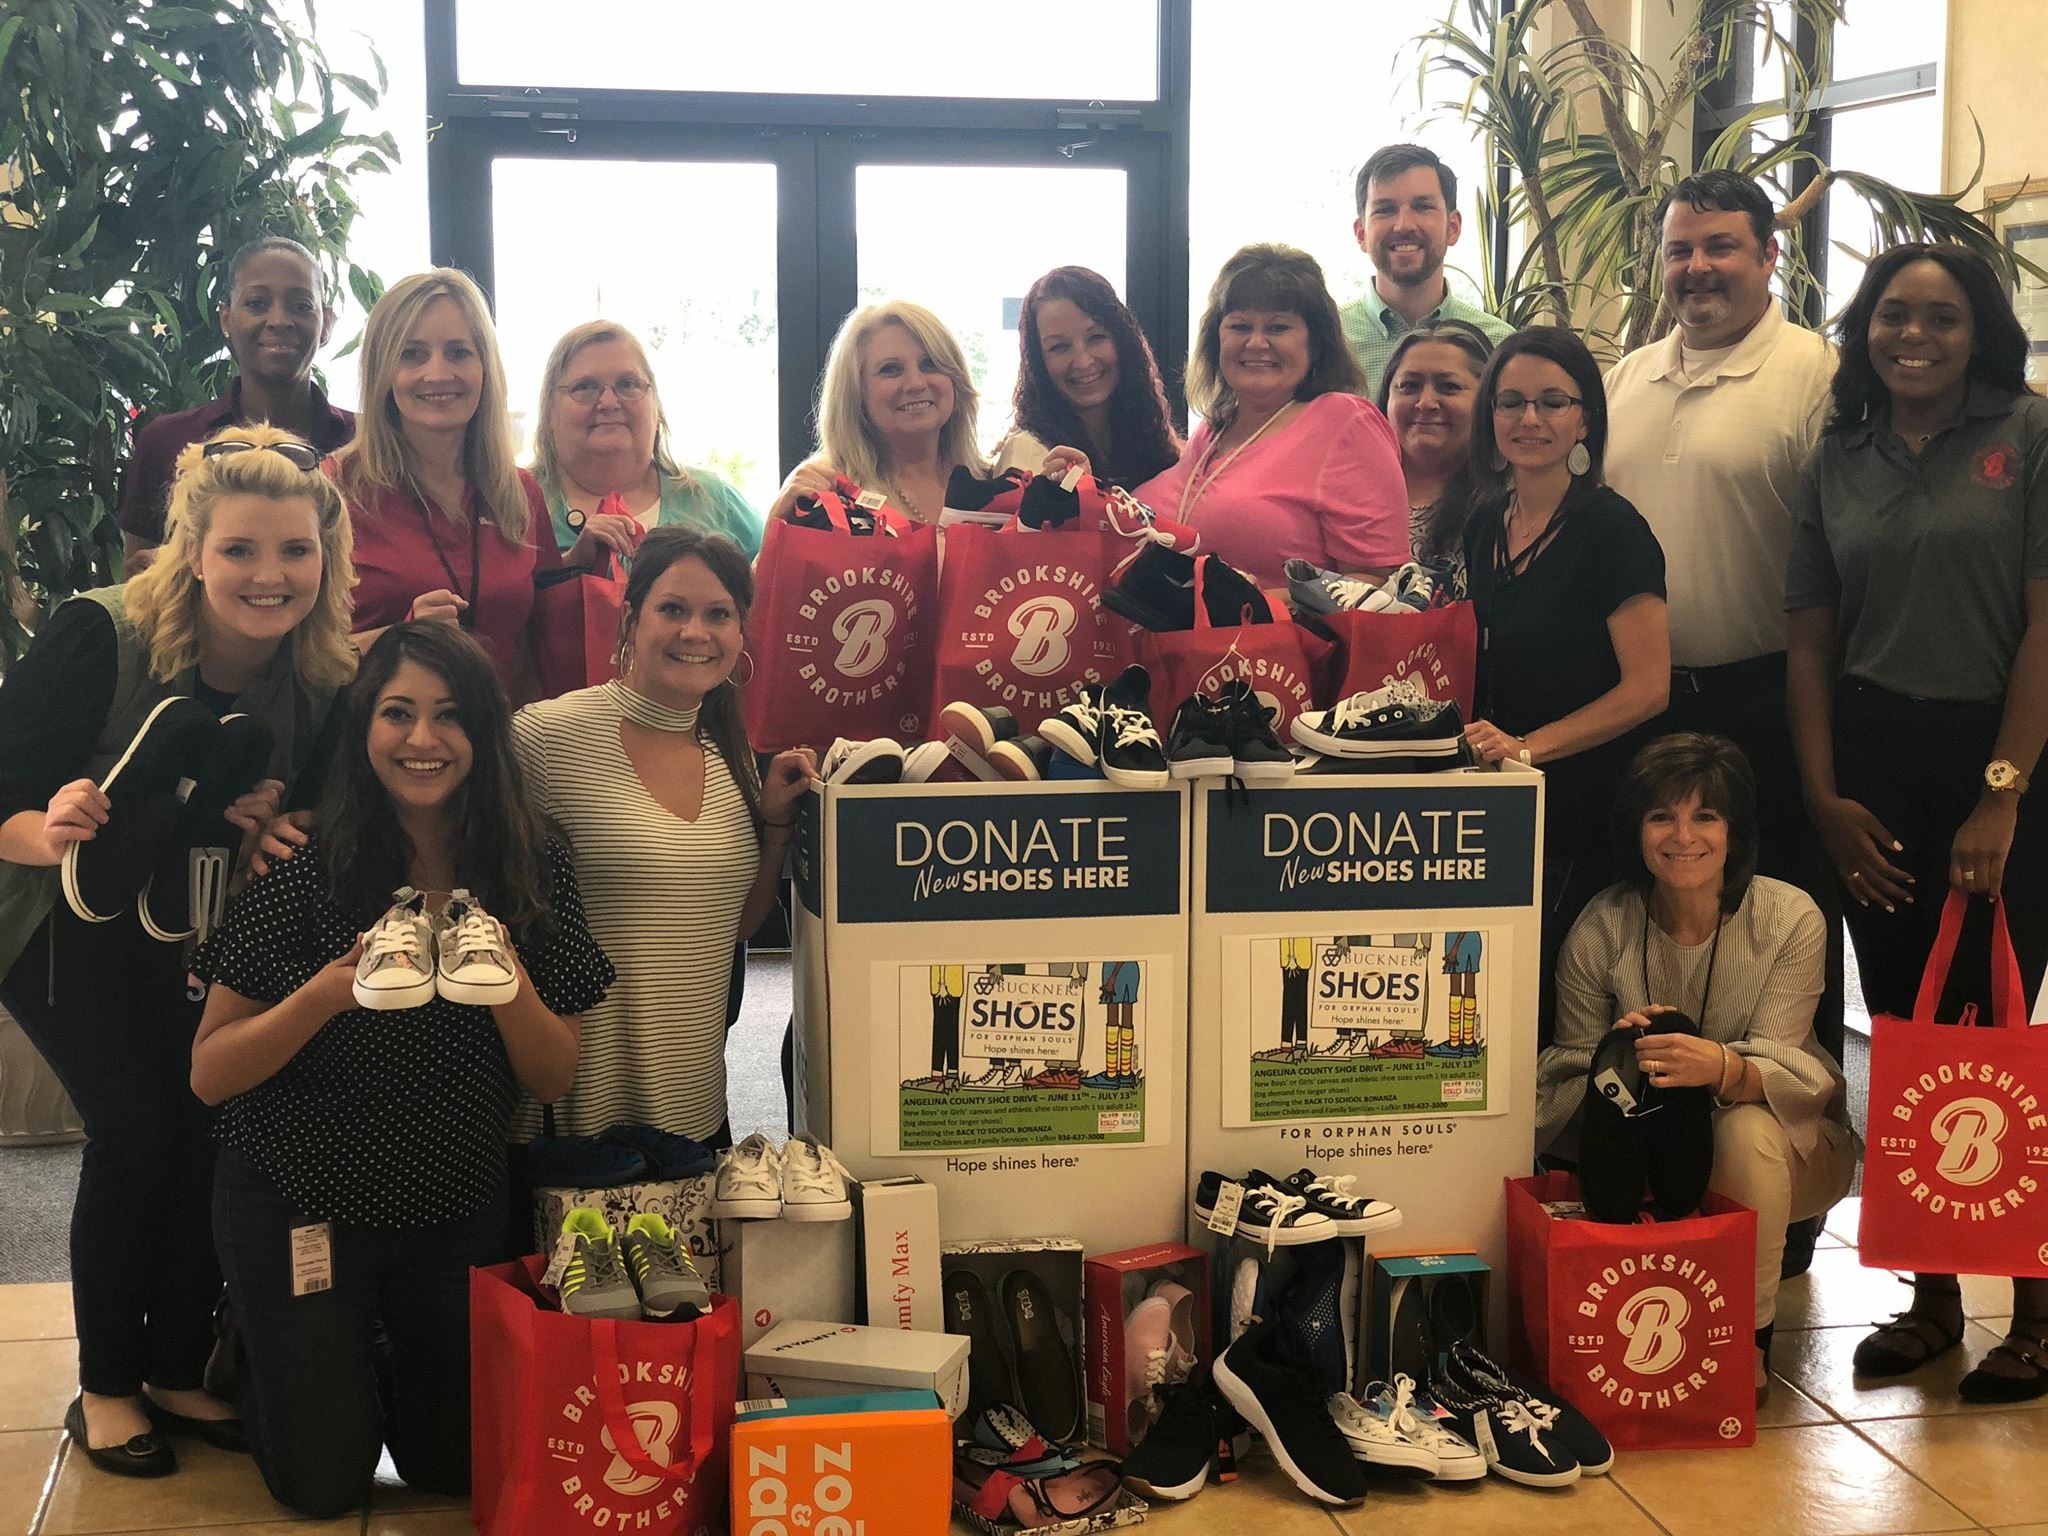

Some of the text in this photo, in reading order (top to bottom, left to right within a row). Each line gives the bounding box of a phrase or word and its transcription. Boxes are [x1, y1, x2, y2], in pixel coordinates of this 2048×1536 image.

[799, 567, 917, 620] BROOKSHIRE
[974, 565, 1107, 626] BROOKSHIRE
[786, 633, 819, 646] ESTD
[961, 632, 994, 641] ESTD
[799, 661, 906, 707] BROTHERS
[975, 658, 1101, 708] BROTHERS
[1205, 658, 1313, 713] OOKSHIRE
[896, 816, 1129, 866] DONATE
[1263, 810, 1486, 857] DONATE
[914, 865, 1129, 902] New SHOES HERE
[1279, 856, 1486, 892] New SHOES HERE
[1345, 953, 1418, 967] BUCKNER
[998, 982, 1074, 997] BUCKNER
[1319, 970, 1420, 1001] SHOES
[970, 999, 1075, 1031] SHOES
[1331, 1015, 1353, 1025] Hope
[1356, 1015, 1380, 1025] shines
[983, 1044, 1006, 1054] Hope
[1009, 1045, 1034, 1055] shines
[995, 1034, 1036, 1042] ORPHAN
[1254, 1068, 1296, 1077] ANGELINA
[1298, 1066, 1333, 1075] COUNTY
[1335, 1065, 1357, 1073] SHOE
[1360, 1064, 1383, 1072] DRIVE
[1392, 1063, 1413, 1071] JUNE
[1441, 1061, 1461, 1069] JULY
[903, 1098, 947, 1106] ANGELINA
[950, 1097, 985, 1105] COUNTY
[987, 1096, 1010, 1104] SHOE
[1013, 1095, 1037, 1103] DRIVE
[1098, 1092, 1117, 1100] JULY
[1892, 1062, 2048, 1131] BROOKSHIRE
[918, 1118, 946, 1126] demand
[988, 1127, 1015, 1135] SCHOOL
[1017, 1125, 1052, 1133] BONANZA
[1280, 1128, 1312, 1139] FOR
[1323, 1126, 1391, 1138] ORPHAN
[1306, 1144, 1345, 1162] Hope
[1350, 1142, 1392, 1157] shines
[1880, 1137, 2048, 1157] ESTD 192
[946, 1157, 987, 1175] Hope
[992, 1155, 1037, 1171] shines
[1897, 1167, 2038, 1222] BROTHERS
[892, 1229, 915, 1331] mfy Max
[1578, 1254, 1725, 1318] BROOKSHIRE
[1568, 1325, 1733, 1346] ESTD 1921
[1100, 1303, 1113, 1398] American Eagle
[1587, 1357, 1718, 1409] BROTHERS
[547, 1438, 585, 1454] ESTD
[561, 1471, 696, 1531] BROTHER
[791, 1503, 812, 1527] &
